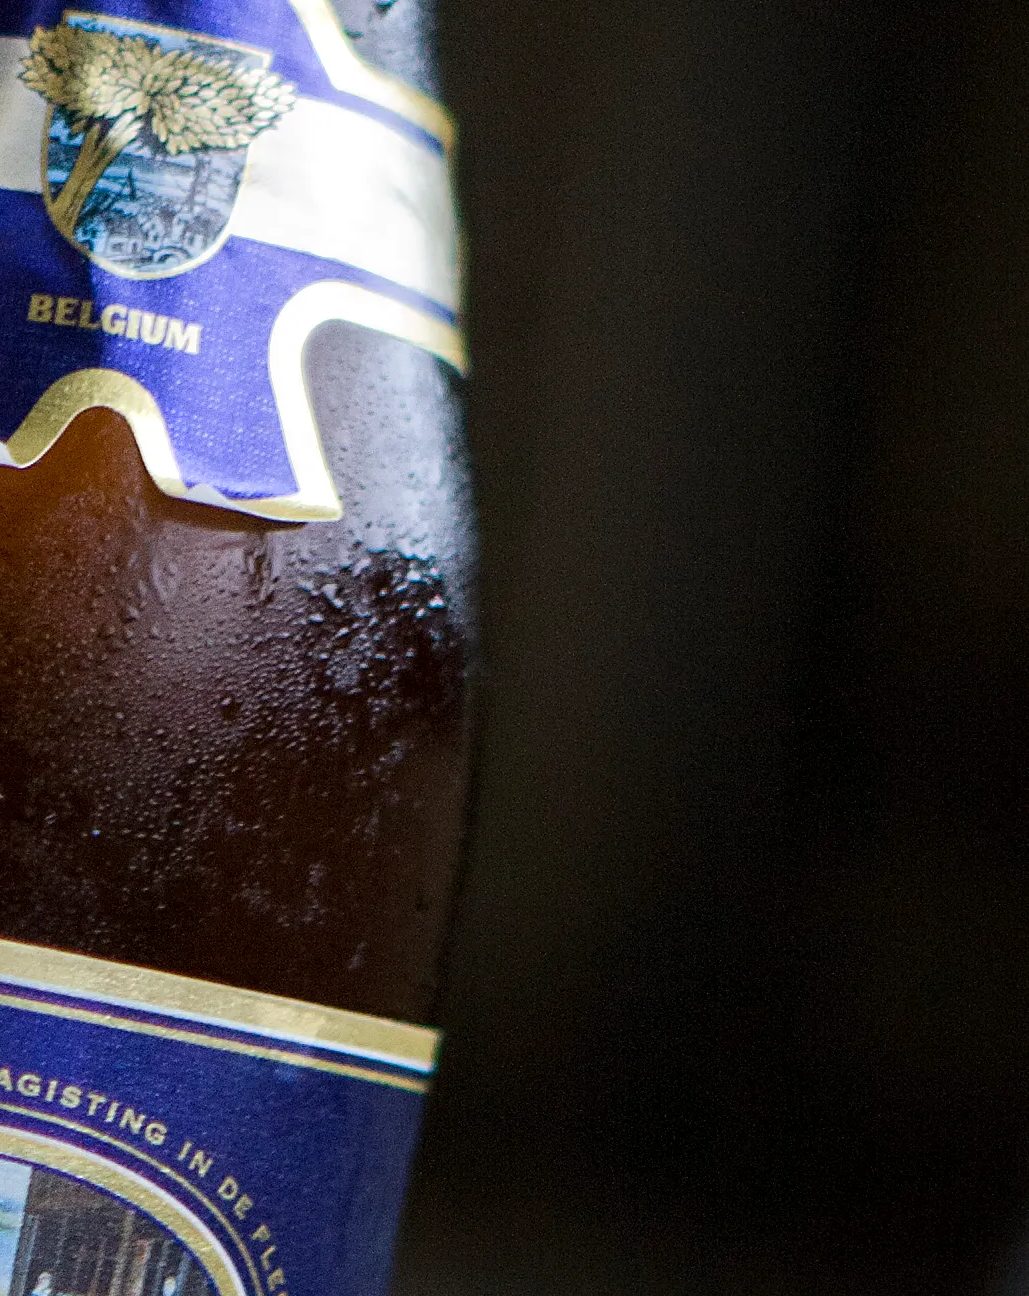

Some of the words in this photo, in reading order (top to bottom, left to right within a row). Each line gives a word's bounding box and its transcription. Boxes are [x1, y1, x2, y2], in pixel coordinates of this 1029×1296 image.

[27, 293, 204, 355] BELGIUM
[177, 1140, 214, 1178] IN
[217, 1176, 254, 1221] DE
